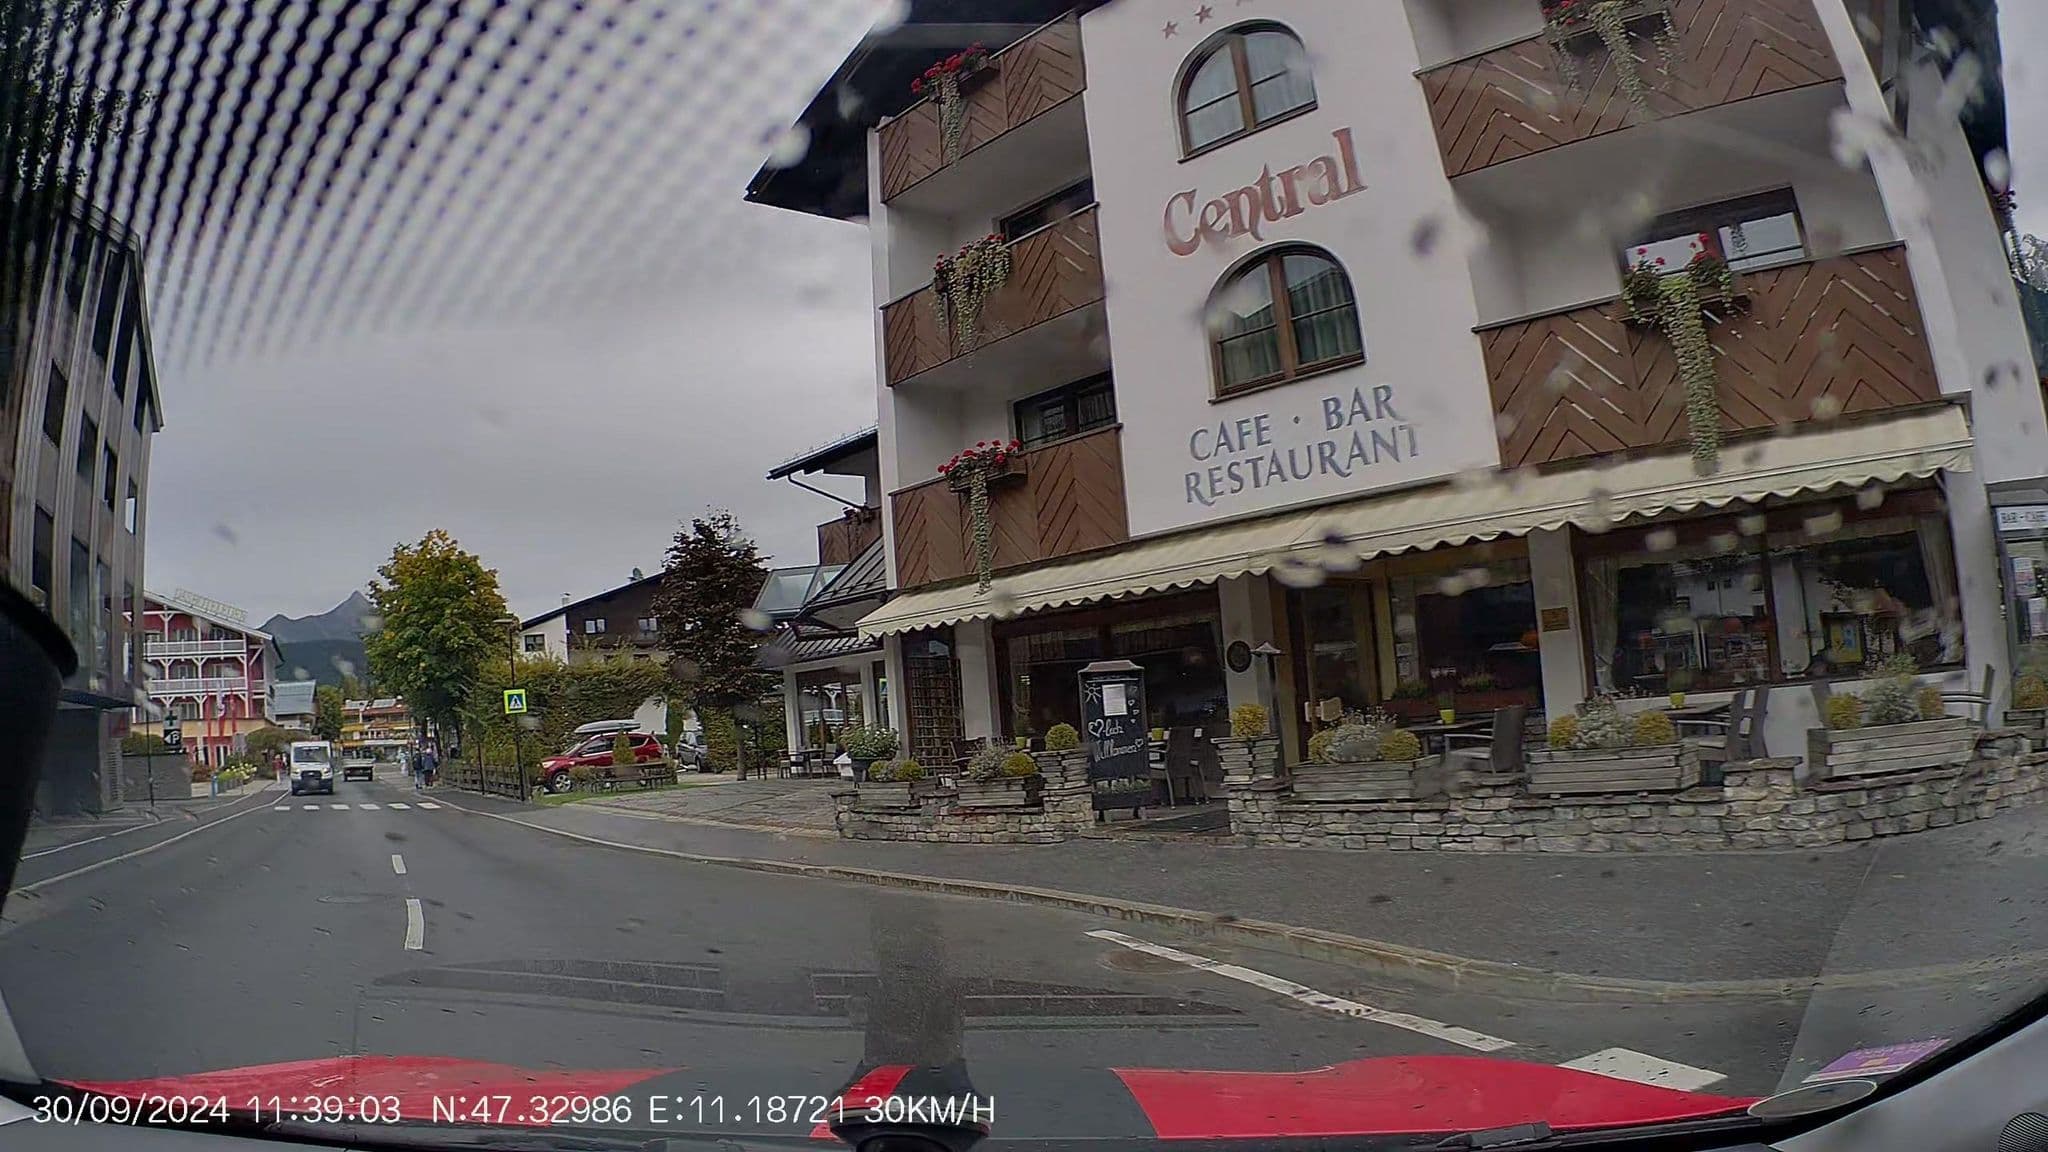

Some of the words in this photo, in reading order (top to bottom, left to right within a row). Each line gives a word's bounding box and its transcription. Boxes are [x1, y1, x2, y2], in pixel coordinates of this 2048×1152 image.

[1163, 126, 1368, 257] Central
[1184, 422, 1421, 507] RESTAURANT
[1189, 413, 1272, 462] CAFE
[1322, 383, 1407, 432] BAR
